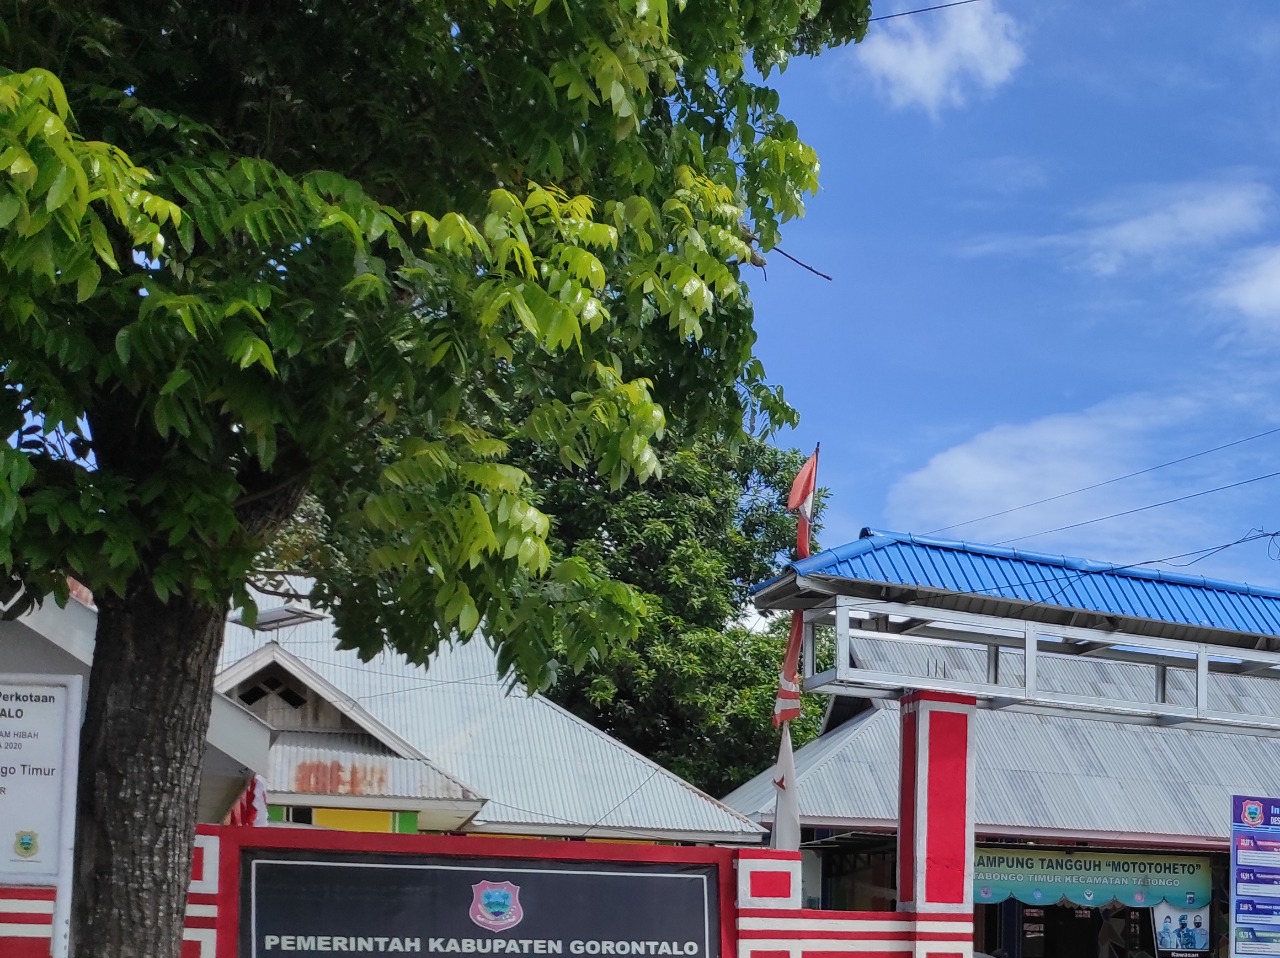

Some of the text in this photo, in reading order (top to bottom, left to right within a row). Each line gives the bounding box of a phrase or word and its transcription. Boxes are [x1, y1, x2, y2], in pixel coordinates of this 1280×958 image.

[0, 691, 55, 704] erkotaan
[13, 731, 39, 739] HIBAH
[4, 742, 22, 750] 2020
[20, 764, 56, 776] Timur
[974, 855, 1035, 870] AMPUNG
[1038, 858, 1101, 872] TANGGUH
[973, 872, 1180, 887] TABONGO TIMUR KECAMATAN TABONGO
[264, 935, 699, 956] PEMERINTAH KABUPATEN GORONTALO
